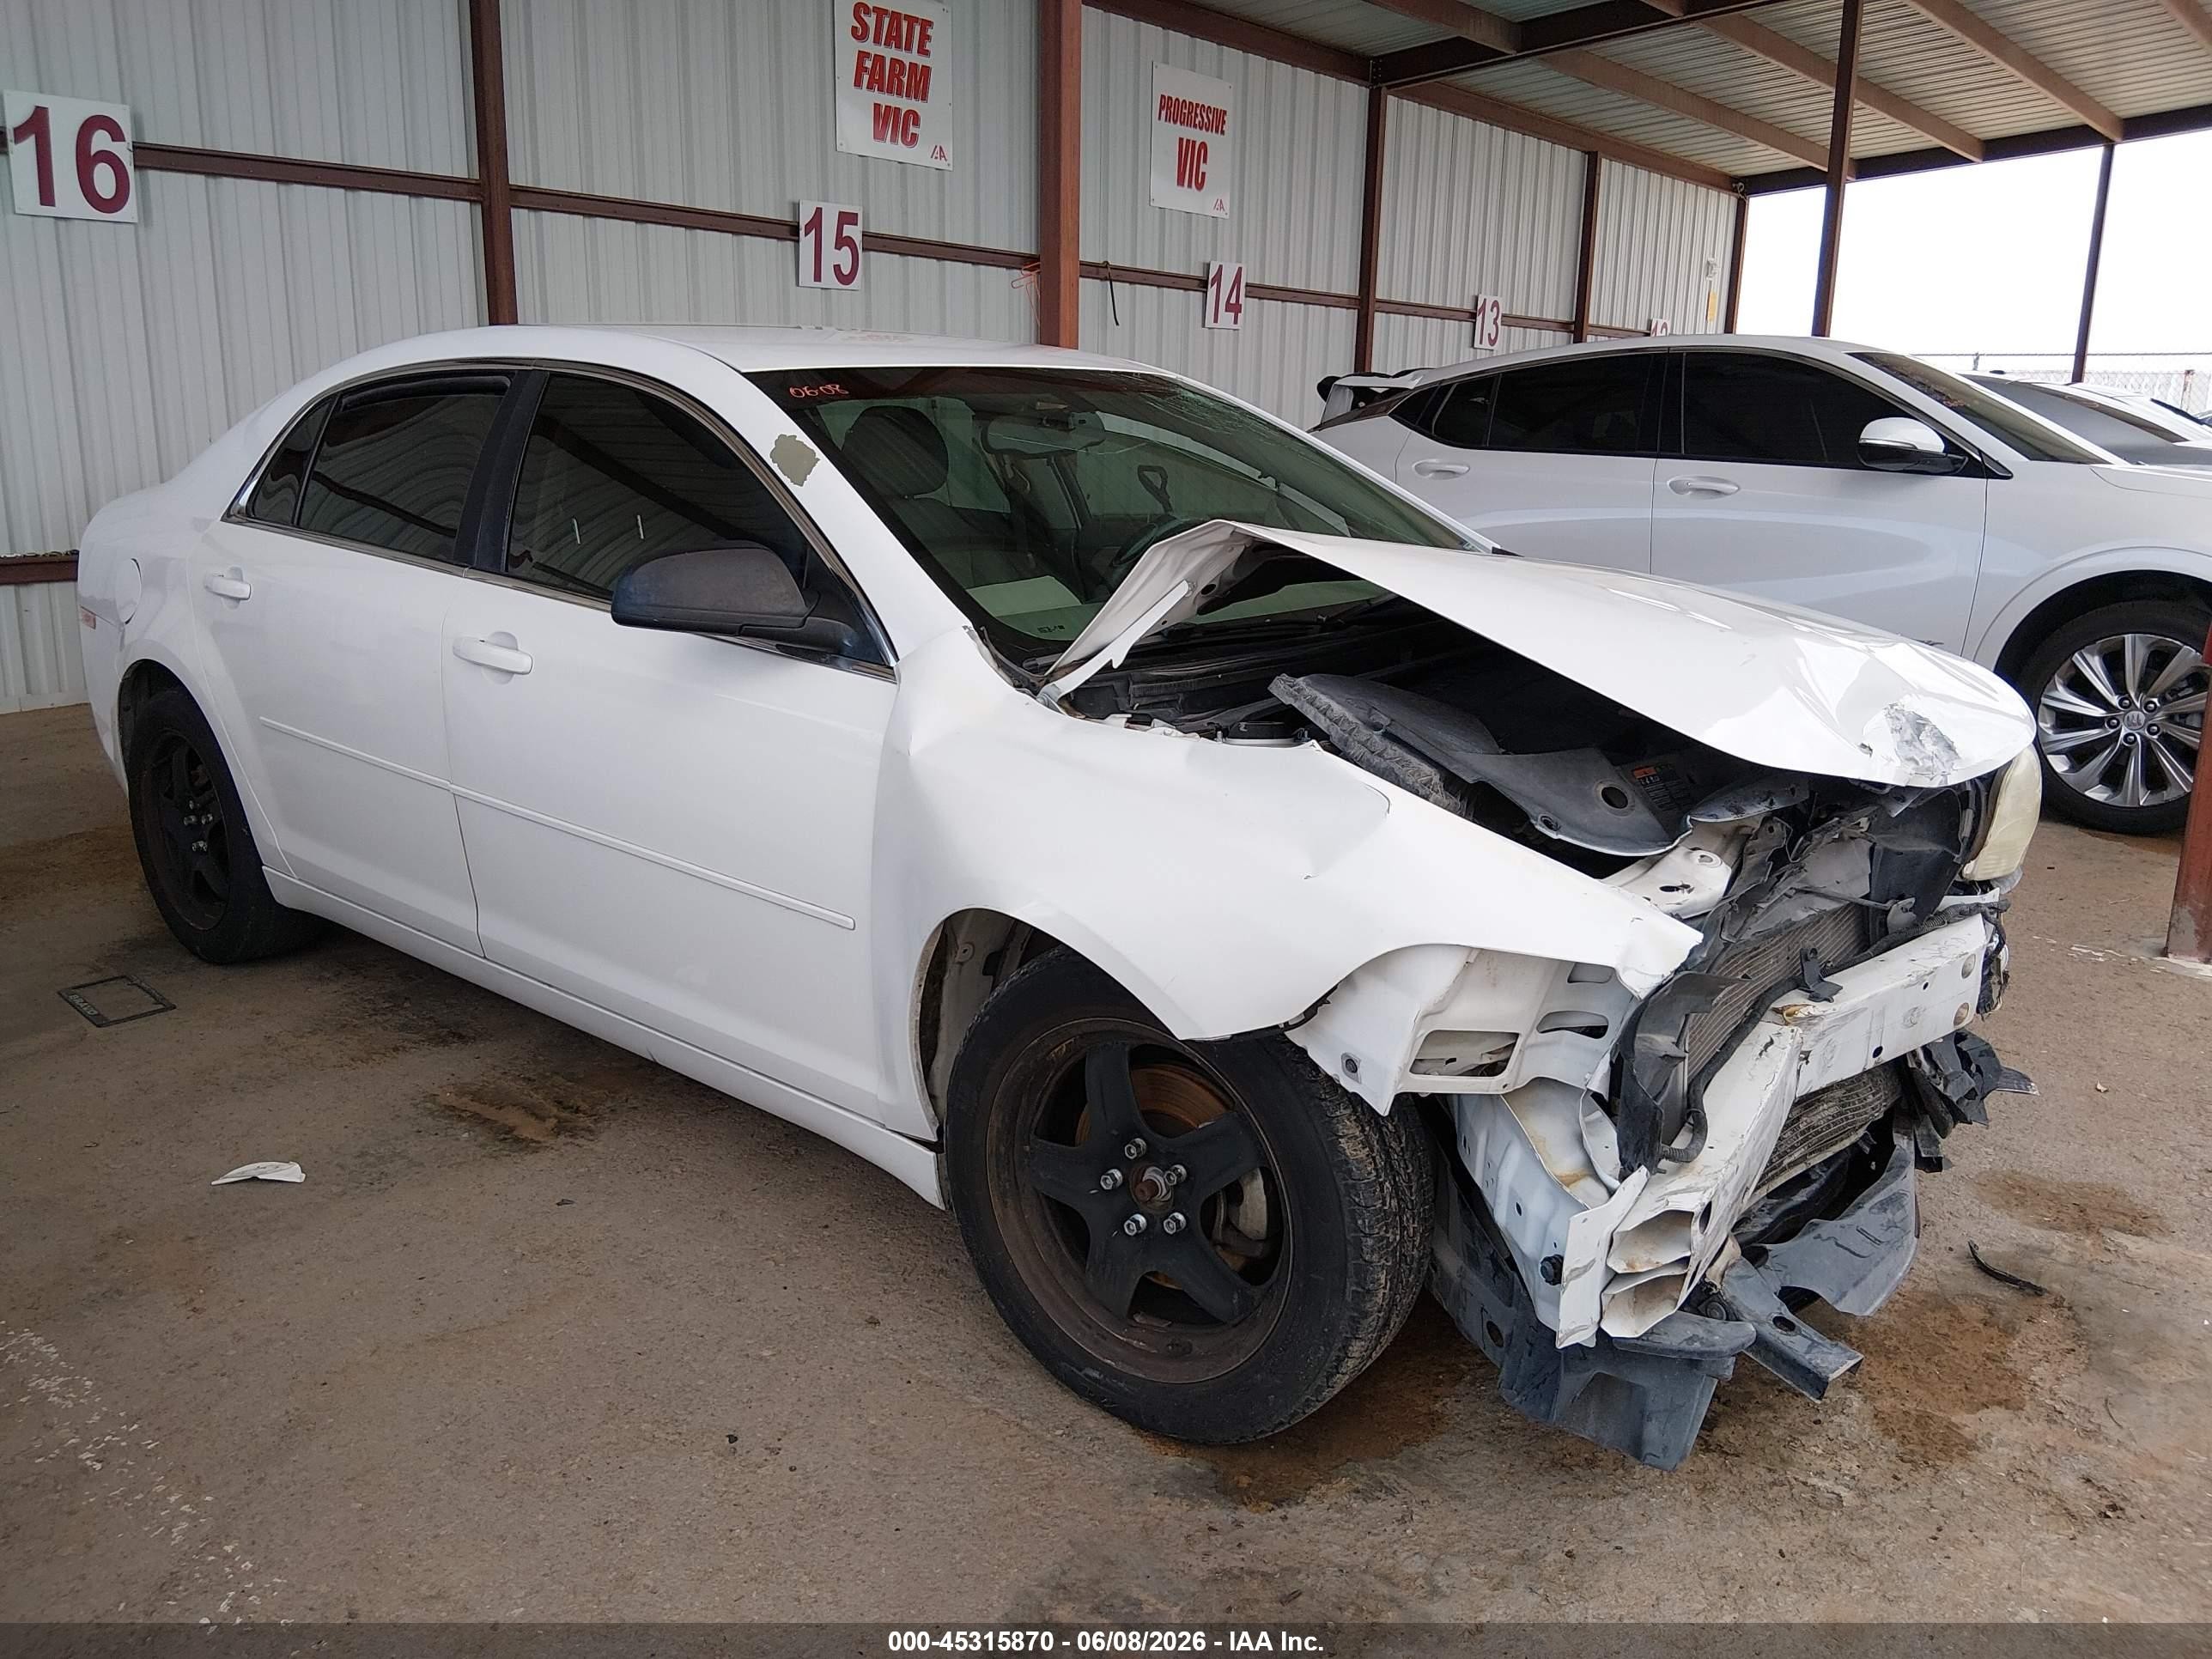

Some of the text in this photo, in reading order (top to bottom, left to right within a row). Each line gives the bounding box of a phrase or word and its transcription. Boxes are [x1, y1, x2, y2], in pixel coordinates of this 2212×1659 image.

[851, 2, 934, 58] STATE
[854, 50, 933, 103] FARM
[872, 102, 921, 149] VIC
[1158, 94, 1228, 137] PROGRESSIVE
[13, 105, 131, 214] 16
[1176, 137, 1209, 192] VIC
[804, 206, 860, 286] 15
[1210, 264, 1243, 325] 14
[1477, 297, 1500, 347] 13
